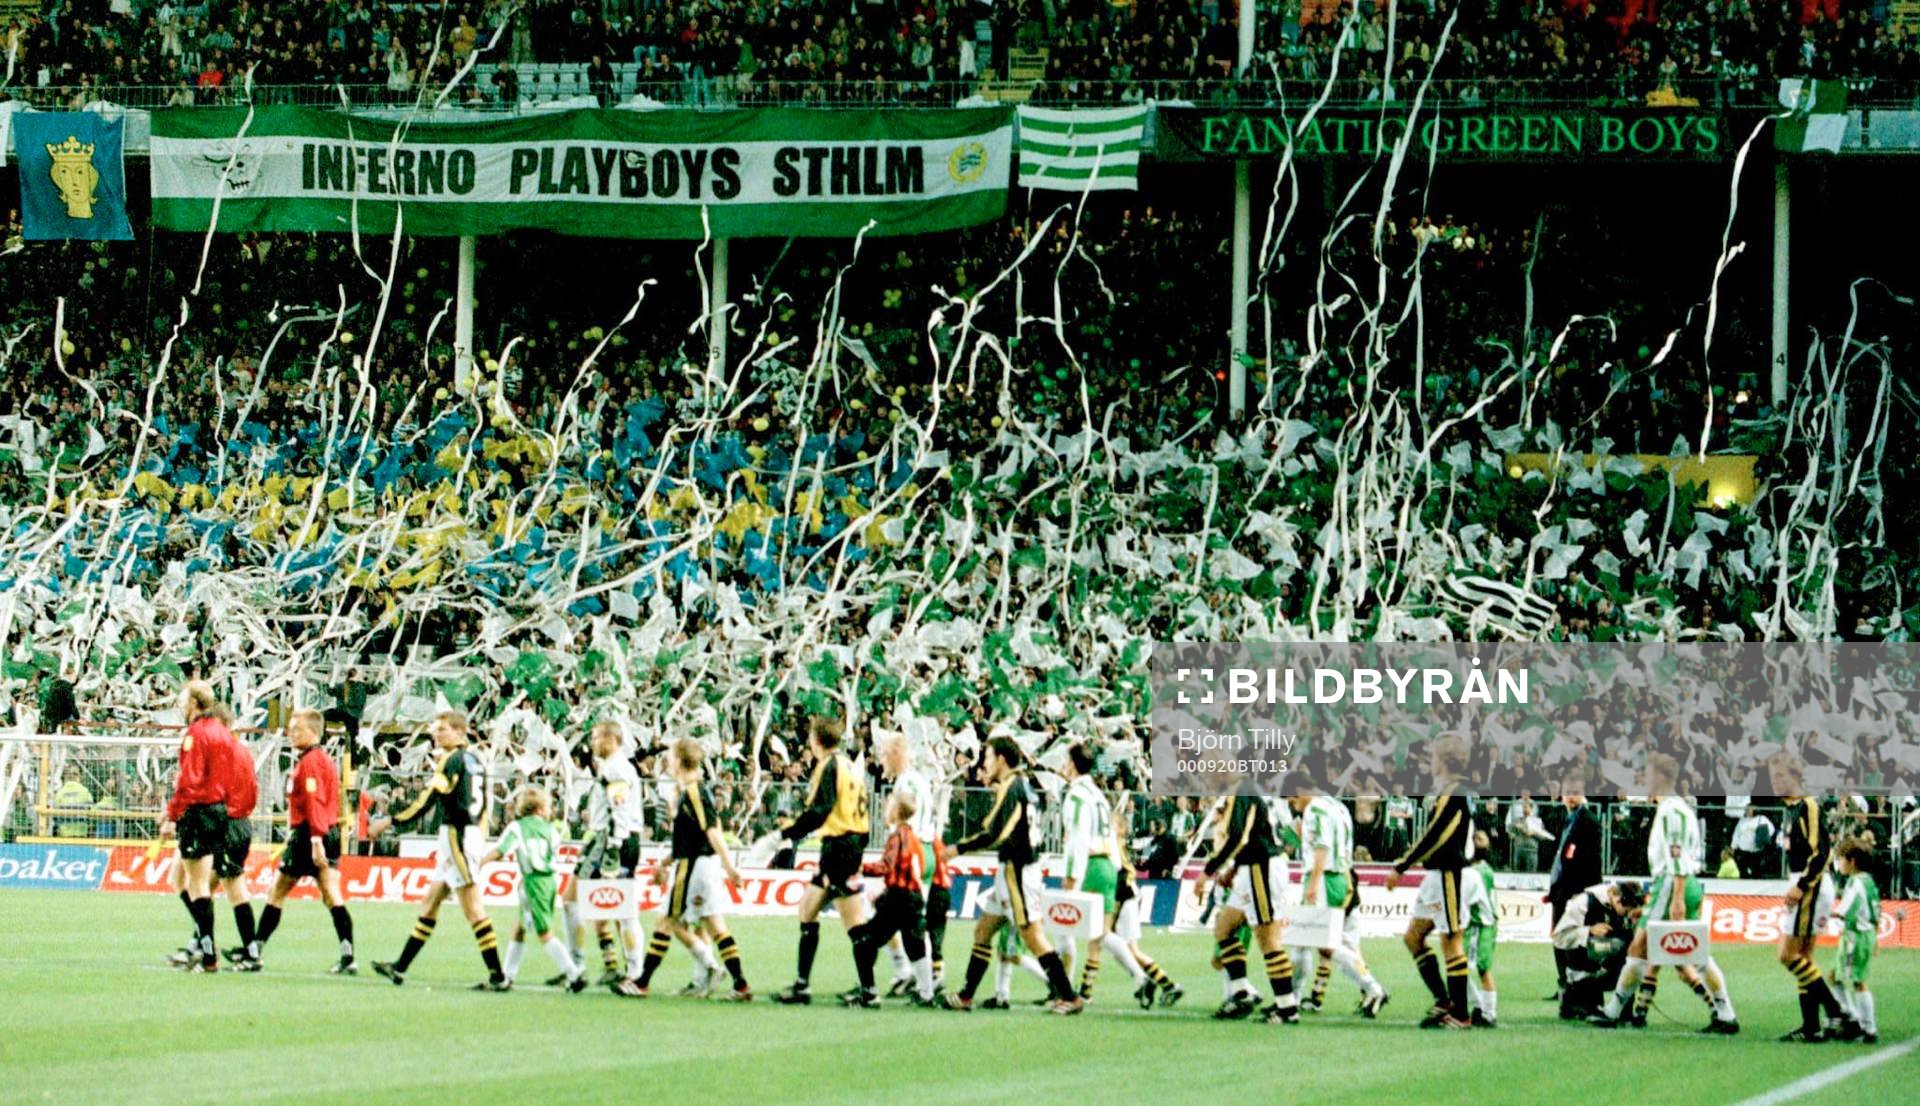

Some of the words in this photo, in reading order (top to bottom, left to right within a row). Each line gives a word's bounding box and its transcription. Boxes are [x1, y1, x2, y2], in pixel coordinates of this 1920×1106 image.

[1202, 116, 1402, 153] FANATIC
[1421, 116, 1582, 153] GREEN
[1600, 116, 1718, 153] BOYS
[303, 143, 476, 195] INFERNO
[509, 147, 741, 200] PLAYBOYS
[773, 146, 924, 197] STHLM
[346, 865, 432, 894] JVC
[590, 887, 625, 905] AXA
[1662, 932, 1696, 950] AXA
